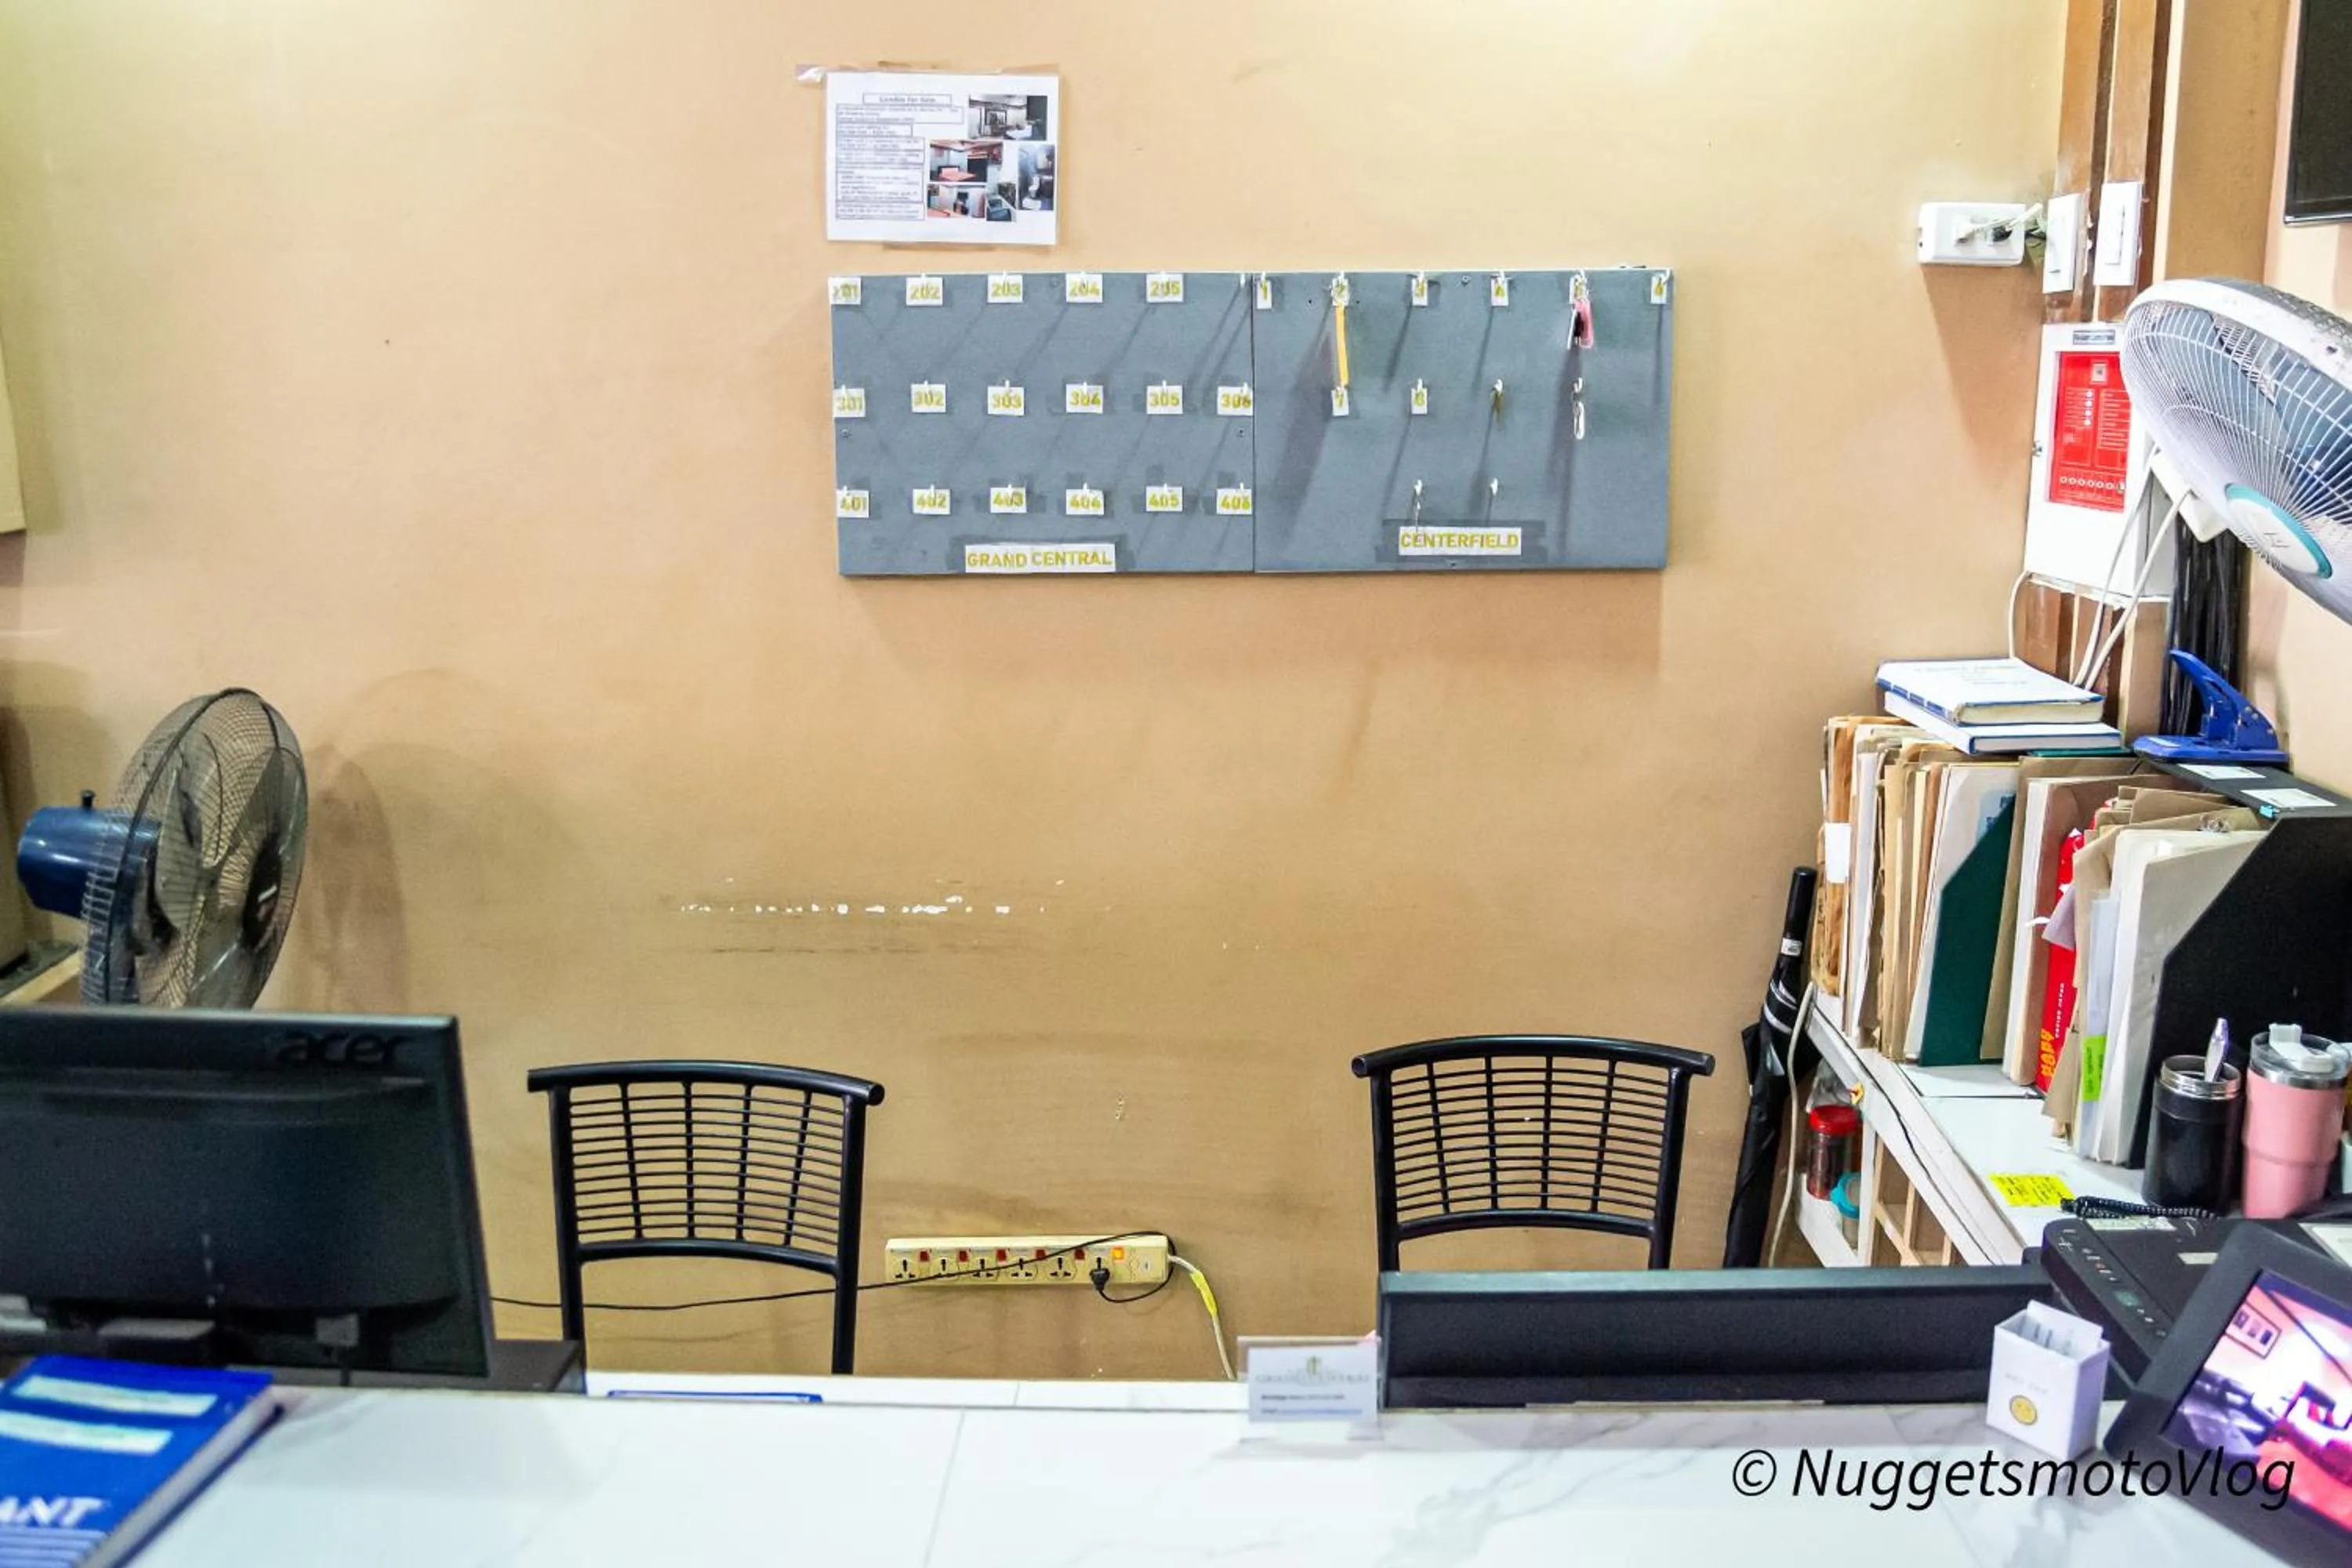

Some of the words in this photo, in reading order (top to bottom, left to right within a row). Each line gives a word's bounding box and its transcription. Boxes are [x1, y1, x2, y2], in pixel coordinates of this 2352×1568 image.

[909, 283, 939, 299] 202
[991, 281, 1021, 297] 203
[1069, 281, 1100, 296] 204
[837, 395, 864, 411] 301
[913, 390, 945, 406] 302
[992, 393, 1022, 408] 303
[1070, 390, 1102, 406] 304
[1149, 392, 1180, 406] 305
[1221, 393, 1251, 408] 306
[916, 493, 946, 508] 402
[993, 492, 1024, 507] 403
[1149, 493, 1180, 508] 405
[1401, 532, 1519, 547] CENTERFIELD
[967, 551, 1027, 568] GRAND
[1031, 550, 1112, 566] CENTRAL
[275, 1029, 416, 1065] acer
